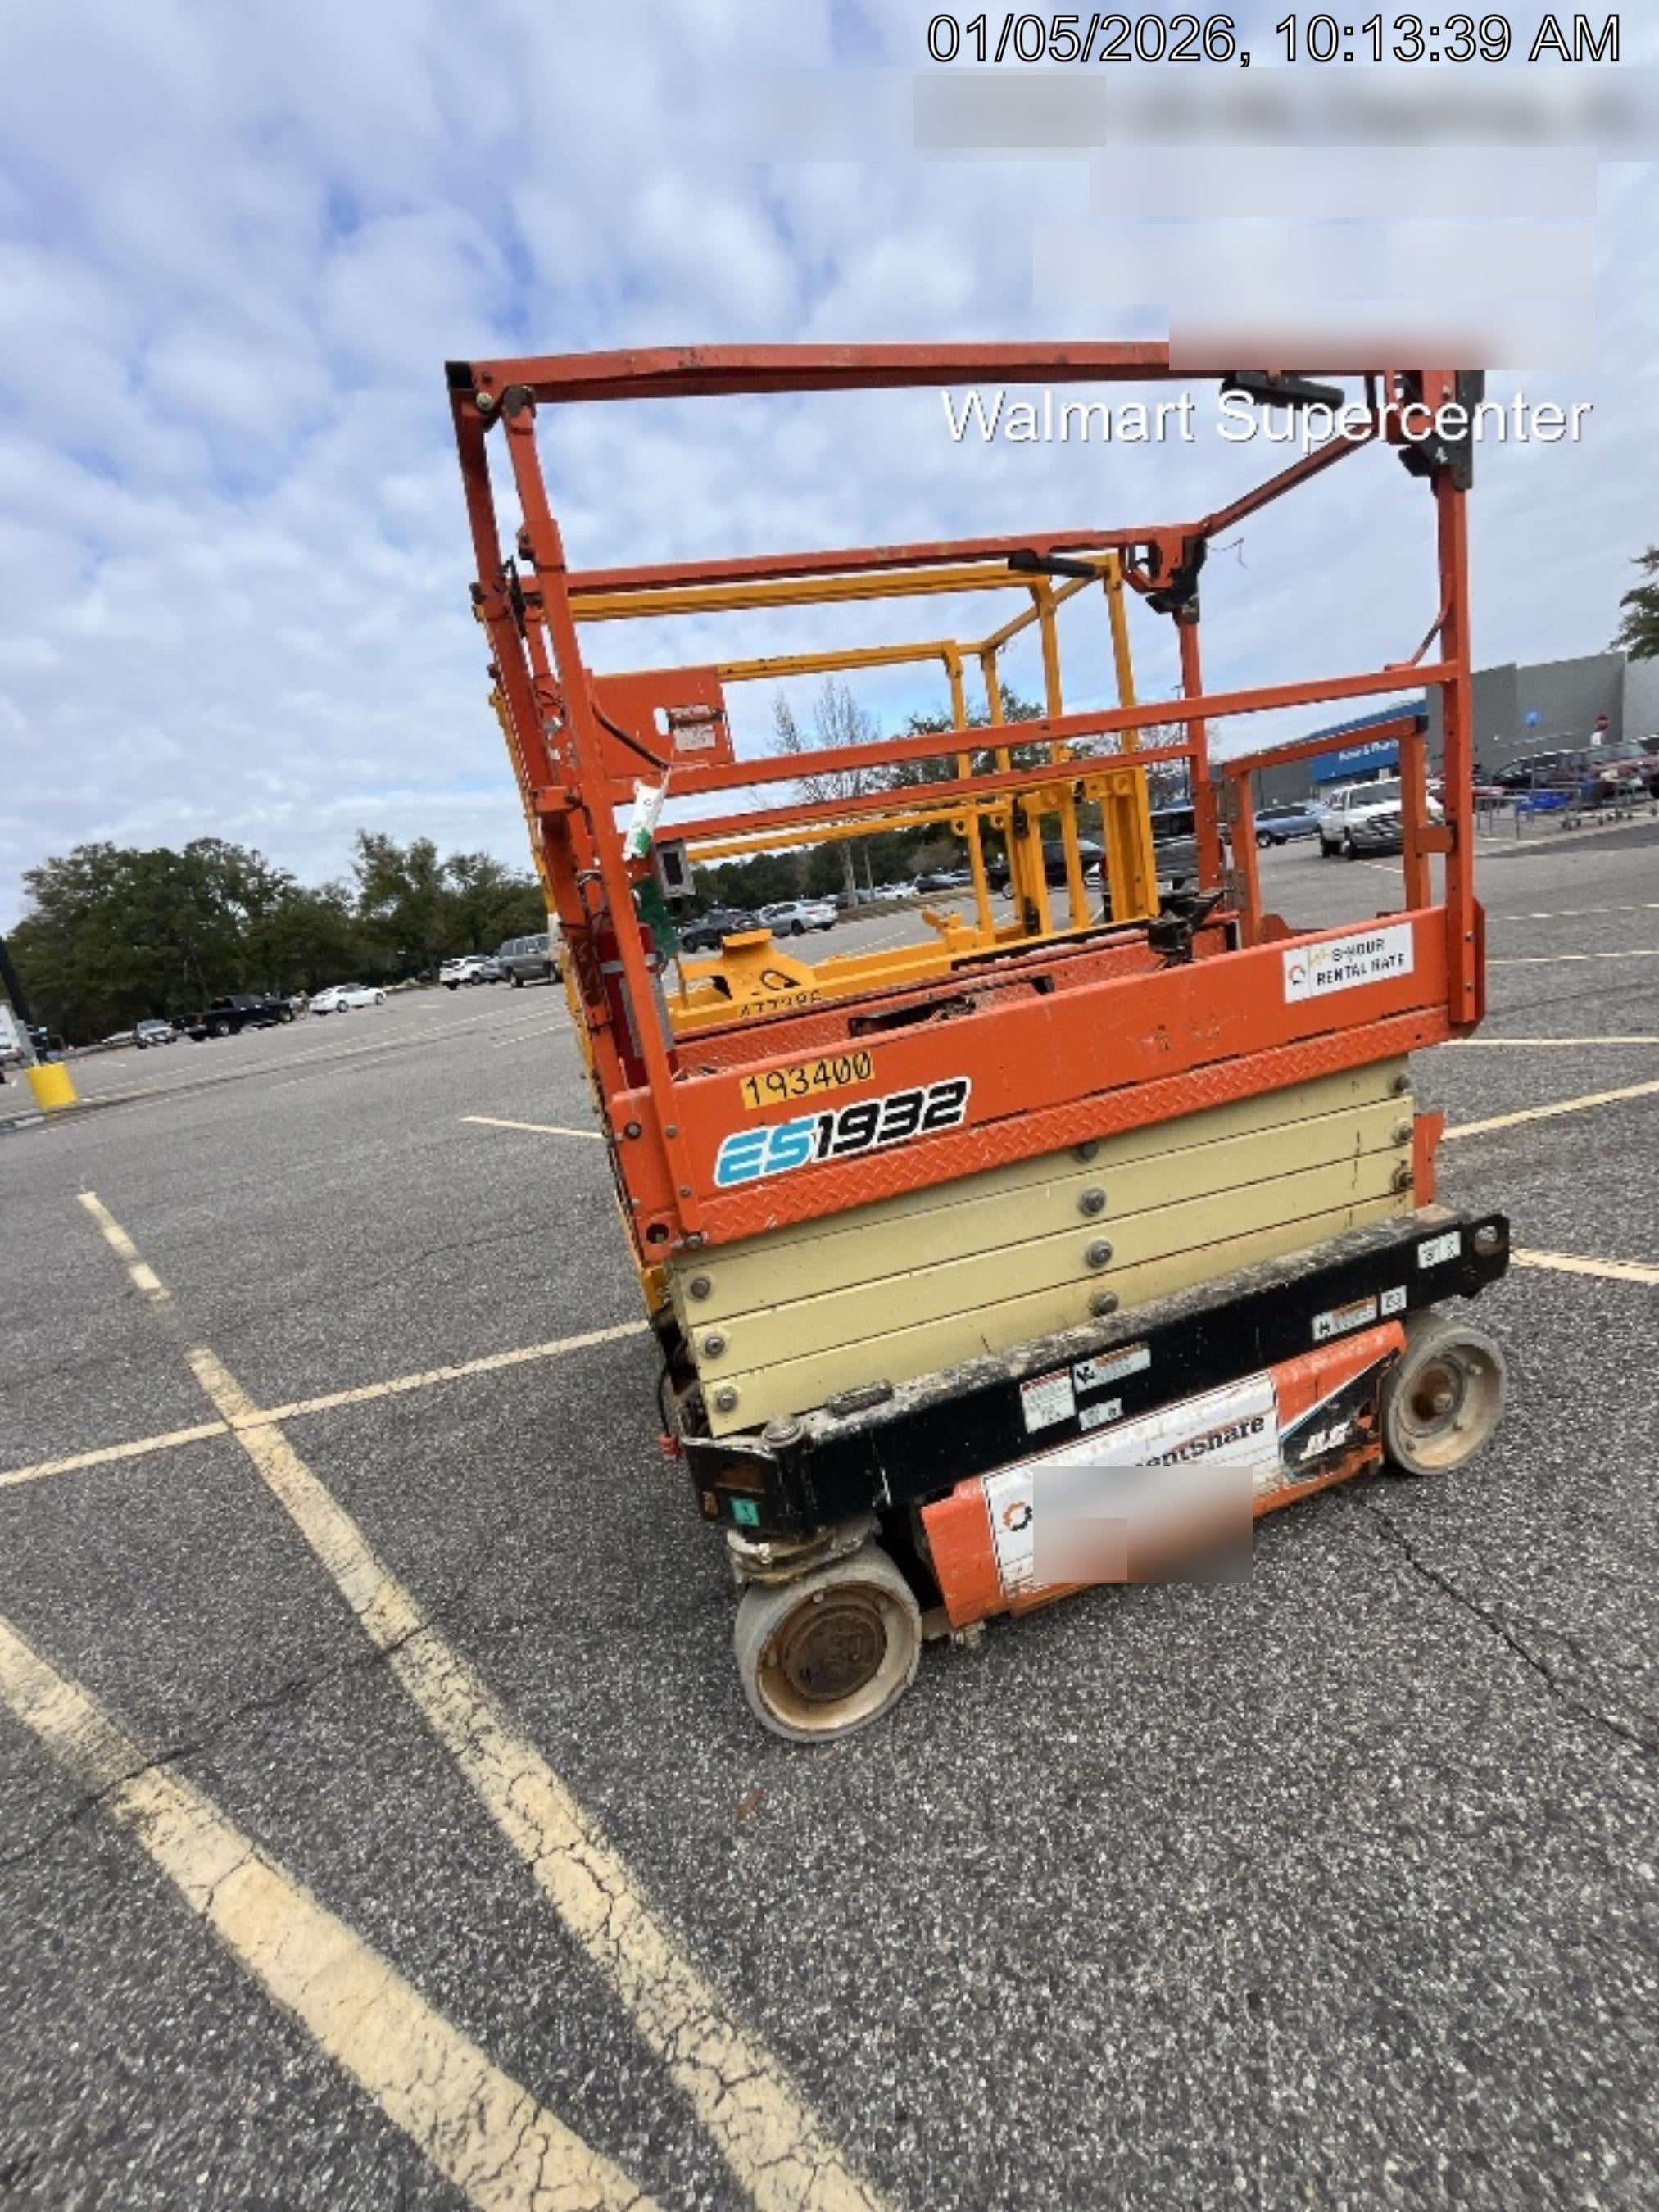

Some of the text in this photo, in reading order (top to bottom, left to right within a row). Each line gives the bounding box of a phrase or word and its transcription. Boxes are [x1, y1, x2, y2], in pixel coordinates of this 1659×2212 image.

[1317, 963, 1367, 986] RENTAL
[746, 1051, 872, 1105] 193400
[714, 1078, 970, 1186] ES1932
